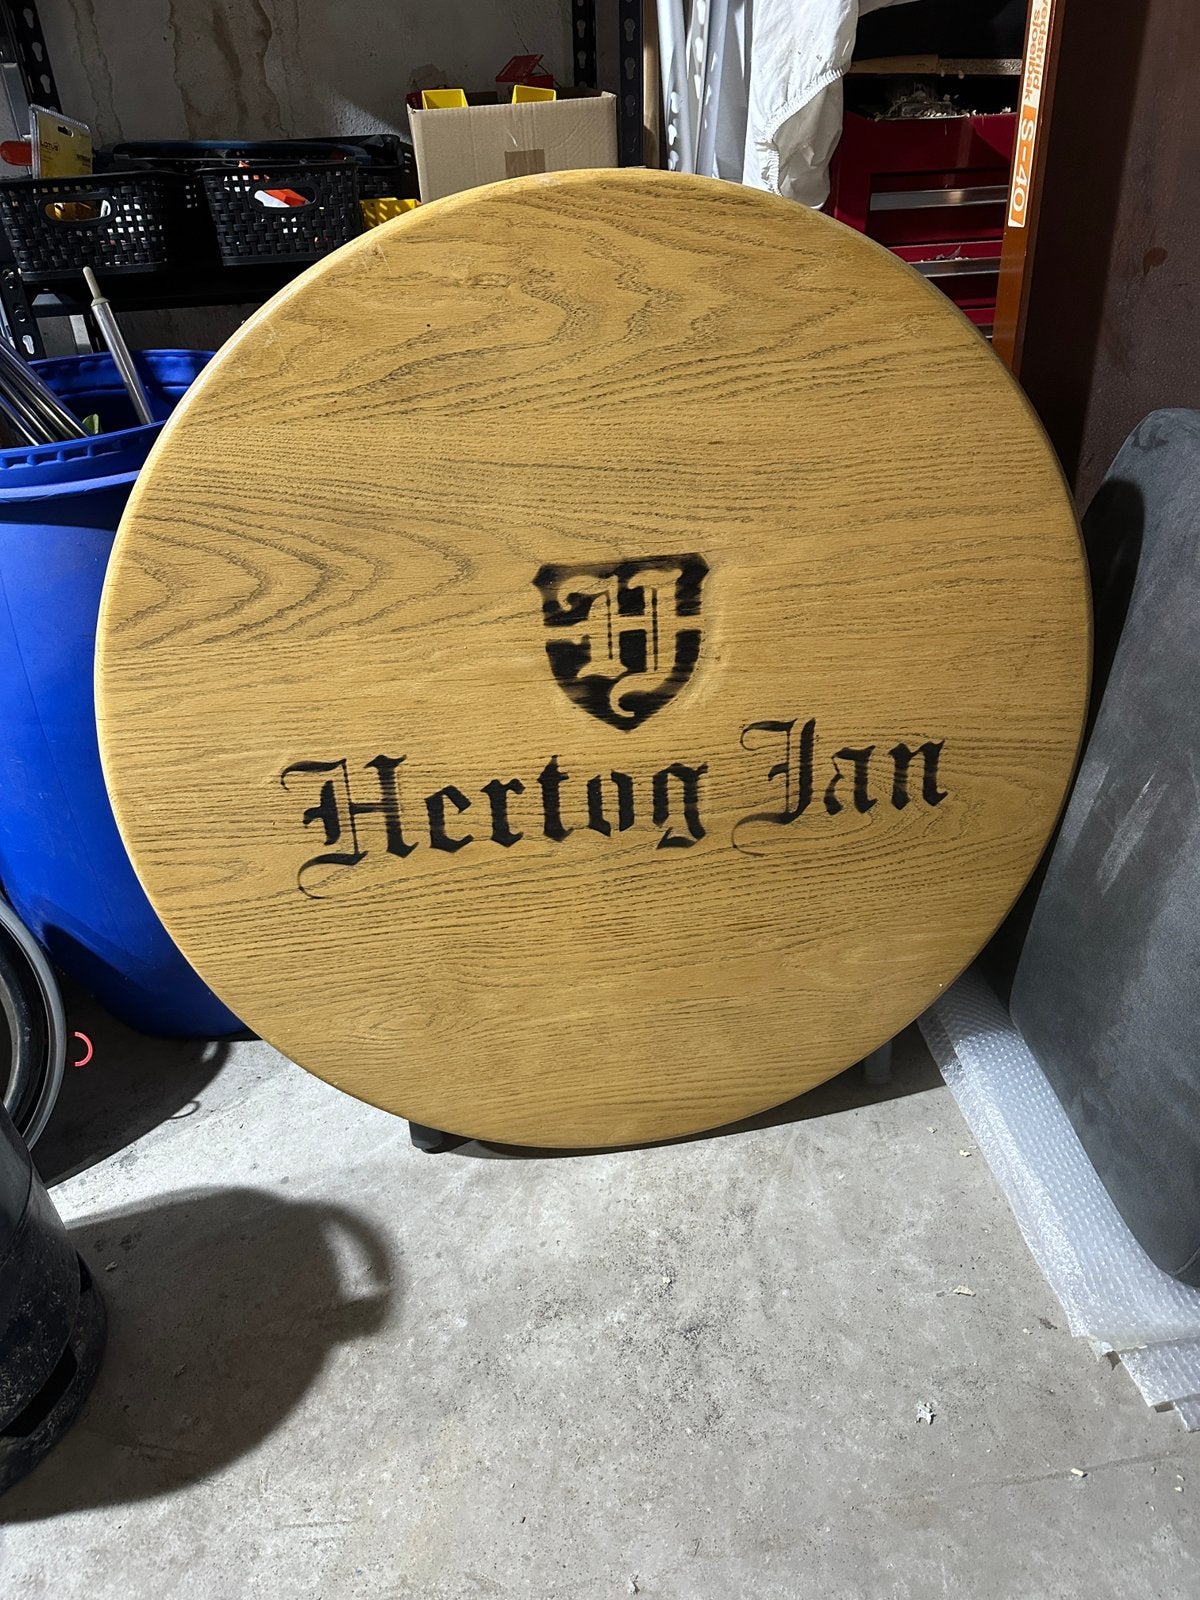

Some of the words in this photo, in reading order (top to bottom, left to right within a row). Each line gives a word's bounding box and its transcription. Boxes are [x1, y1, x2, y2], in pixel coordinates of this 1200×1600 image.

[1025, 9, 1041, 100] sjoelbak
[1014, 119, 1035, 211] S-40
[281, 754, 709, 899] Hertog
[731, 718, 948, 856] Jan
